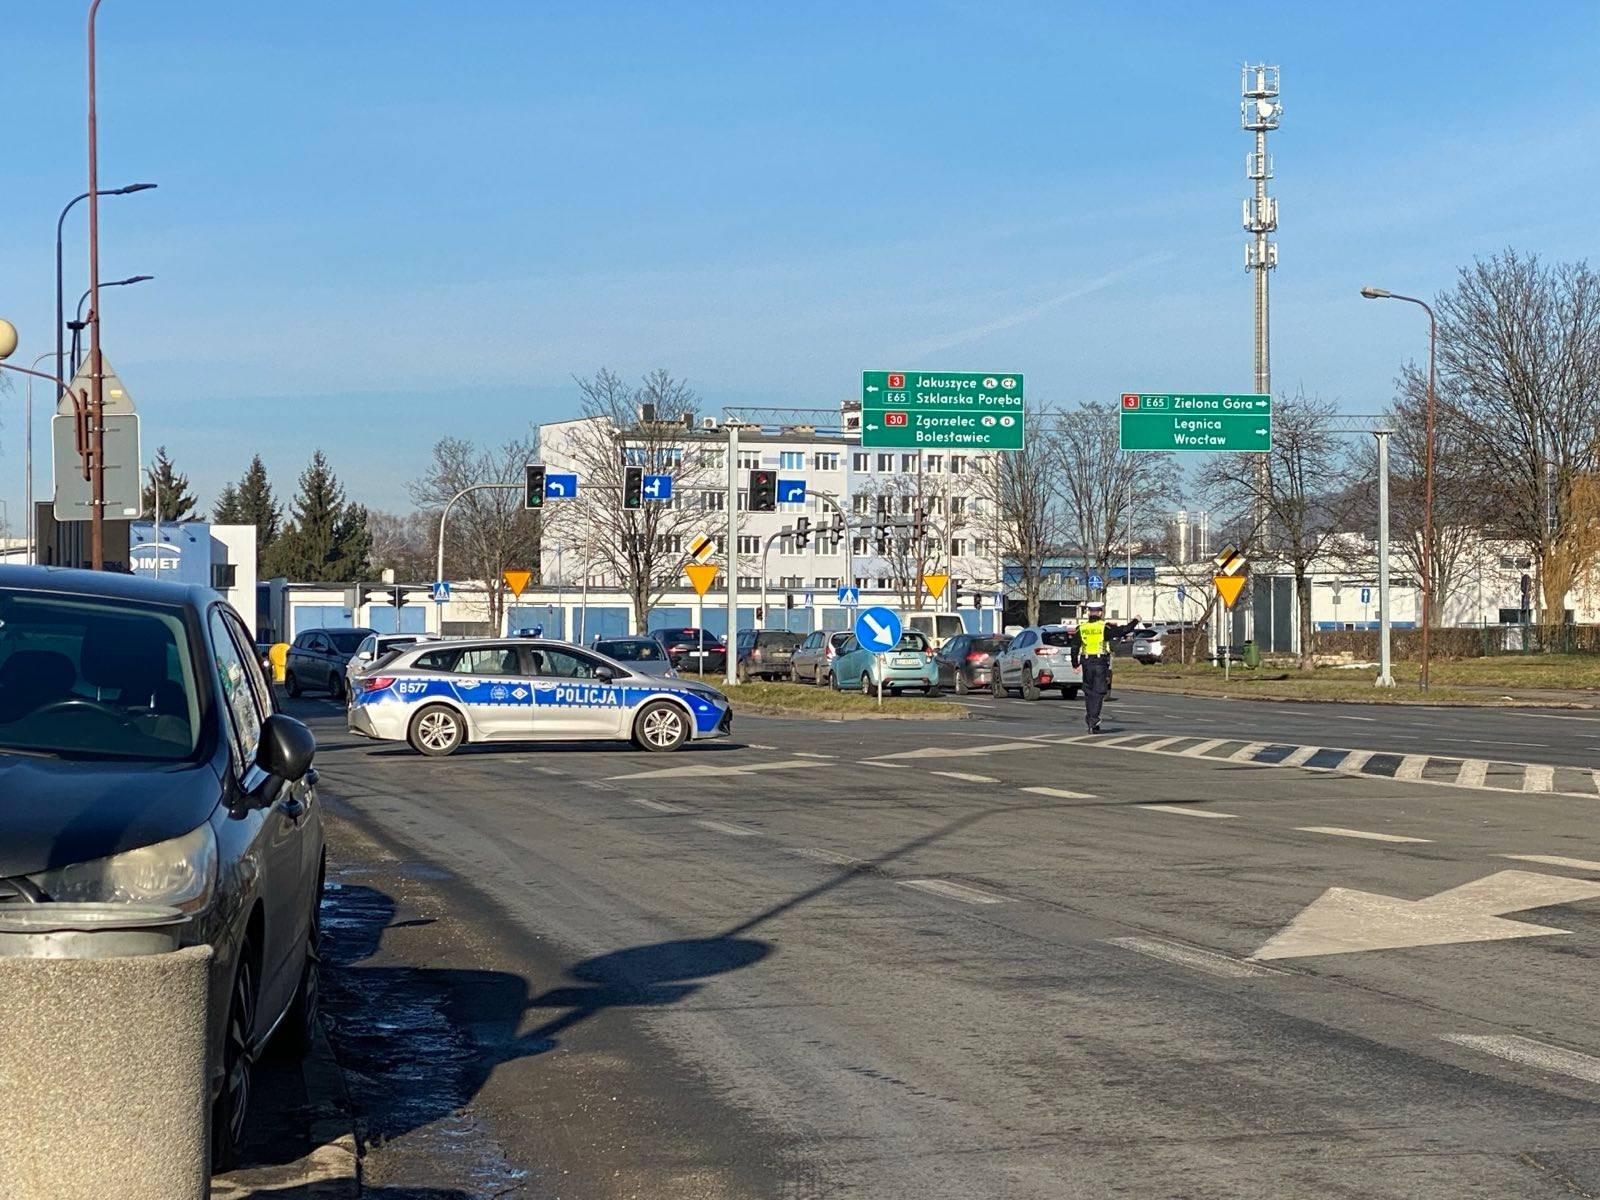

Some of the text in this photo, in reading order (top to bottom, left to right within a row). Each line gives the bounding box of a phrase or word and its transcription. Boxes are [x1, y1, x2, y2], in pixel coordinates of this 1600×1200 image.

[893, 376, 900, 386] 3
[916, 376, 977, 391] Jakuszyce
[985, 379, 995, 387] PL
[916, 392, 1021, 407] Szklarska Poręba
[1128, 399, 1135, 407] 3
[1174, 398, 1253, 409] Zielona Góra
[889, 415, 903, 425] 30
[916, 415, 975, 428] Zgorzelec
[984, 417, 993, 425] PL
[1174, 418, 1222, 431] Legnica
[916, 430, 990, 443] Bolesławiec
[1174, 434, 1226, 445] Wrocław
[555, 687, 617, 705] POLICJA
